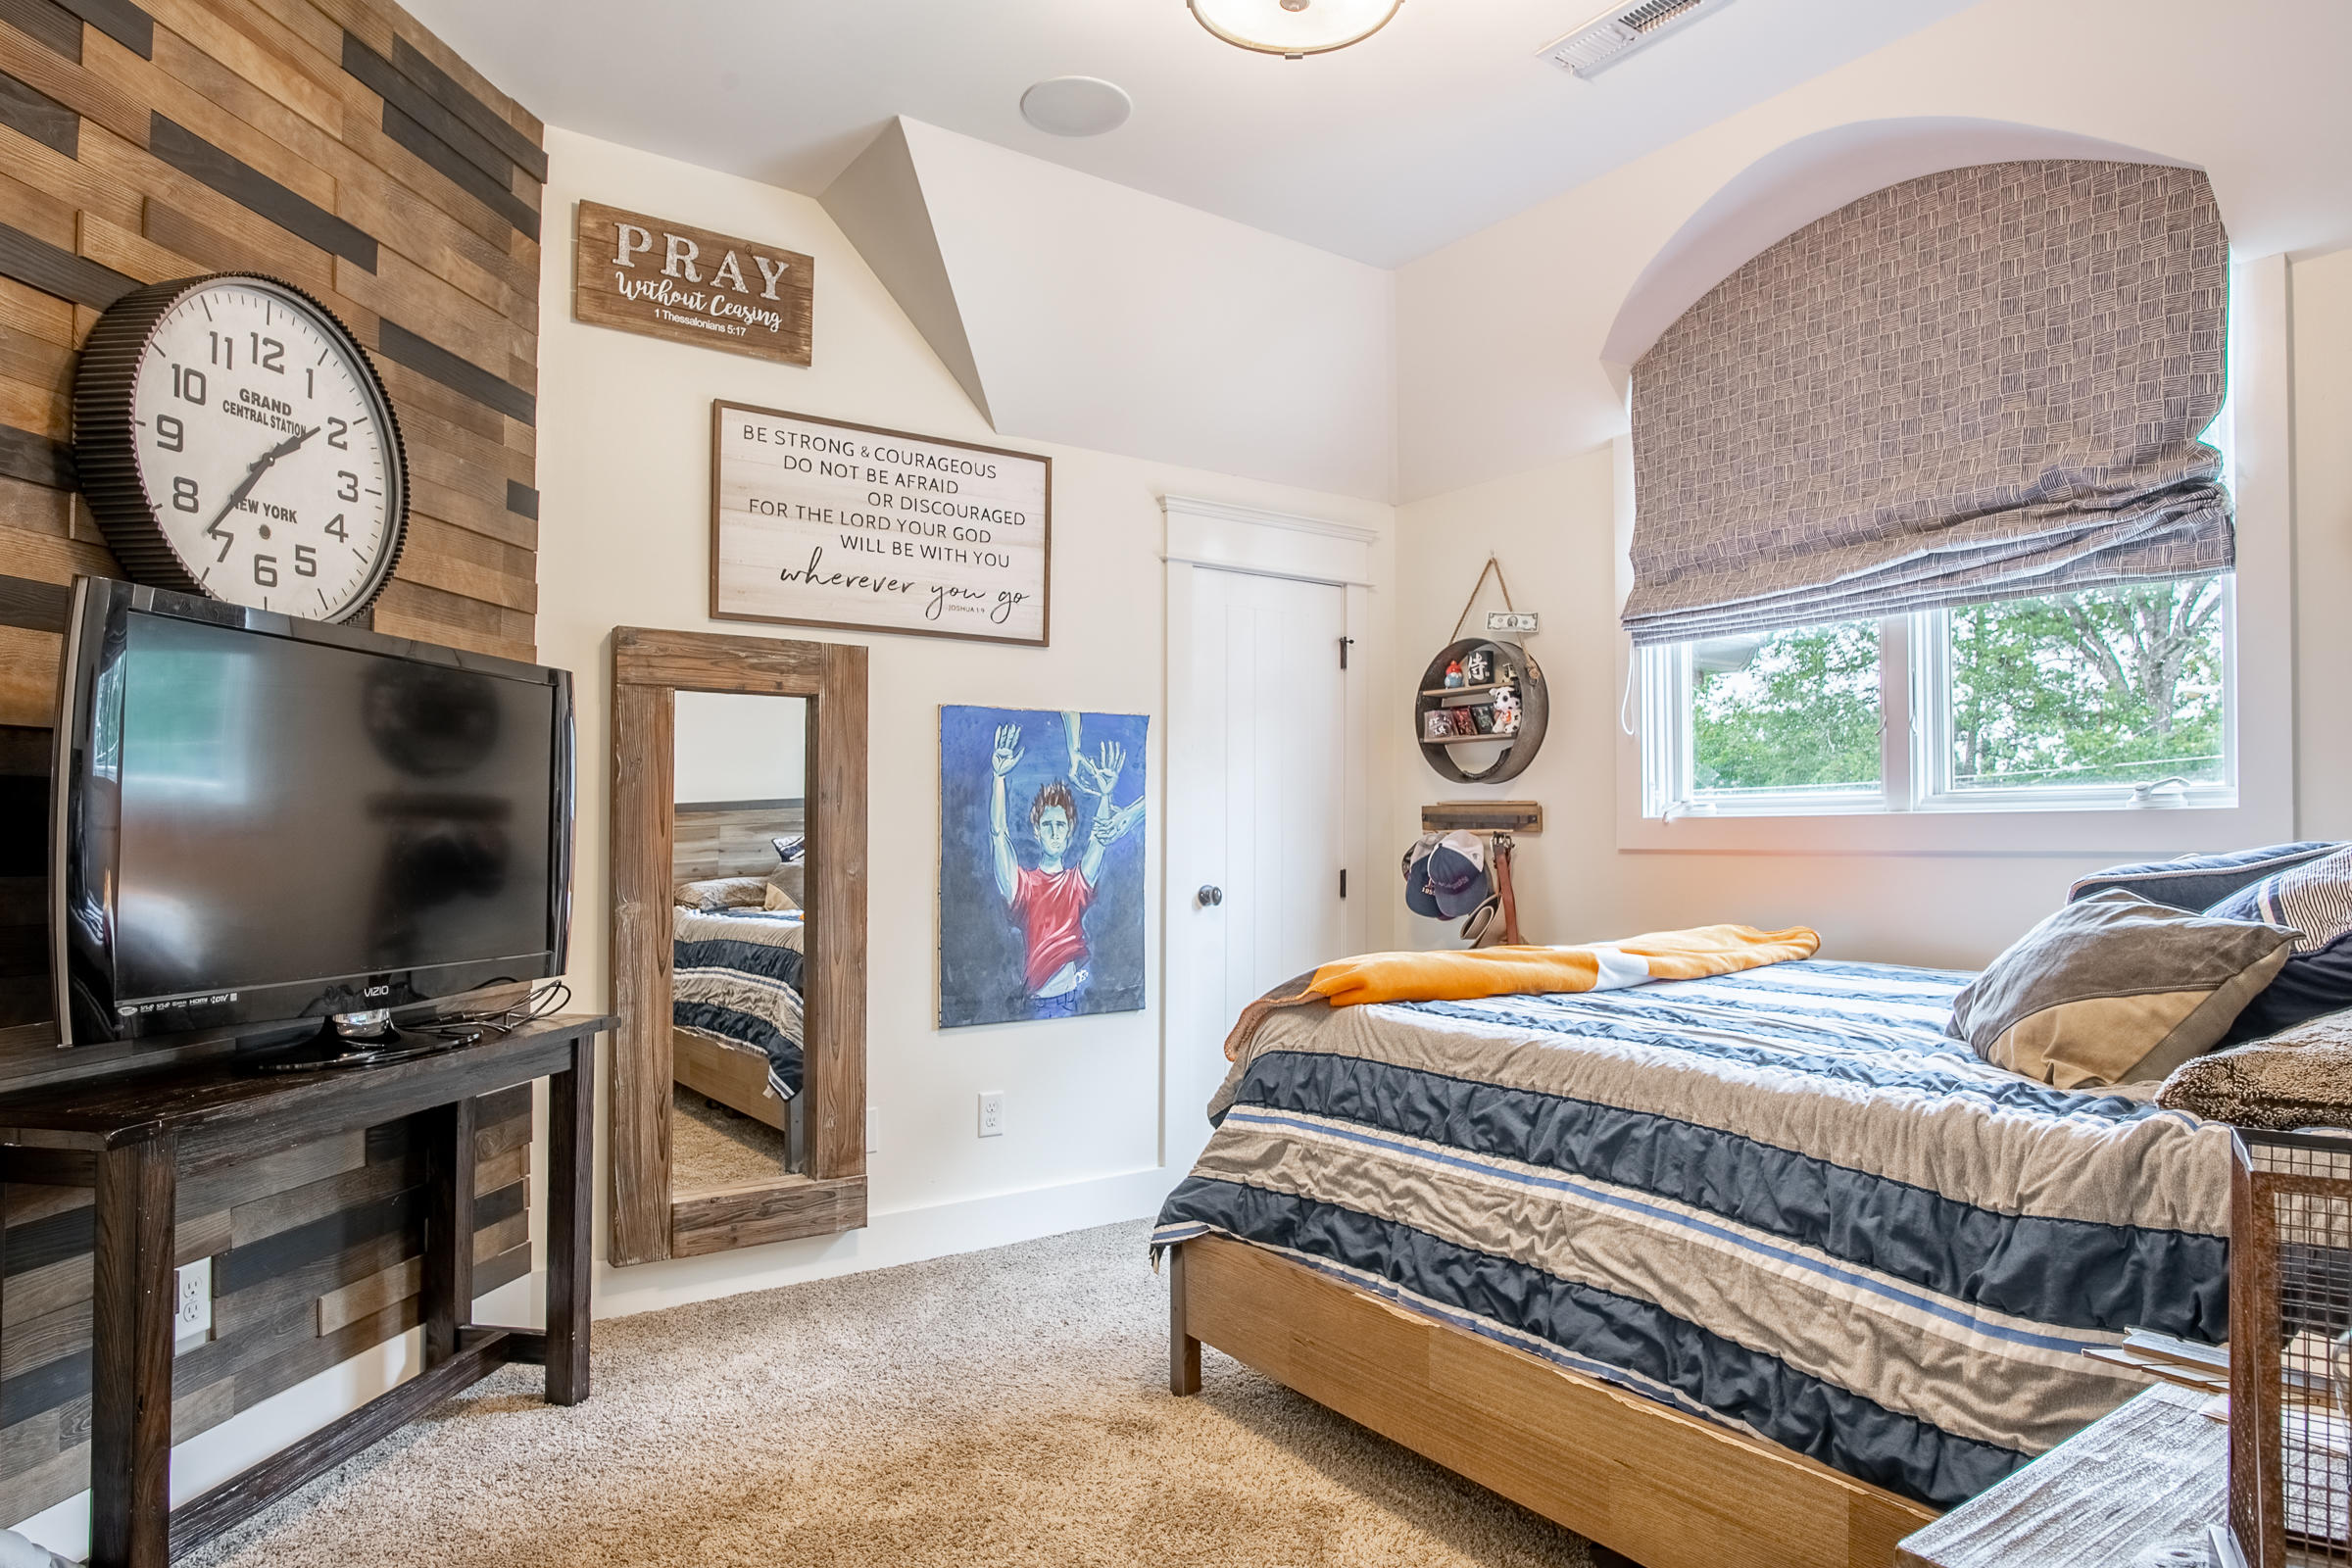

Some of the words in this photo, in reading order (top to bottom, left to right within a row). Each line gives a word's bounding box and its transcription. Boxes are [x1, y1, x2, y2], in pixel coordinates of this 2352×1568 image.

[612, 221, 789, 301] PRAY
[615, 270, 707, 310] Without
[710, 295, 782, 333] Ceasing
[655, 308, 661, 318] 1
[662, 309, 726, 333] Thessalonians
[727, 325, 747, 337] 5:17
[209, 331, 233, 370] 11
[250, 331, 285, 374] 12
[172, 363, 207, 406] 10
[306, 368, 315, 399] 1
[222, 399, 270, 426] CENTRAL
[270, 414, 308, 438] STATION
[239, 387, 293, 416] GRAND
[157, 414, 184, 453] 9
[327, 416, 349, 451] 2
[743, 424, 767, 443] BE
[774, 429, 856, 458] STRONG
[861, 445, 870, 458] &
[874, 446, 998, 479] COURAGEOUS
[337, 469, 359, 503] 3
[784, 455, 812, 473] DO
[819, 461, 859, 480] NOT
[866, 468, 889, 485] BE
[895, 473, 958, 494] AFRAID
[172, 475, 199, 514] 8
[867, 491, 894, 509] OR
[900, 496, 1026, 526] DISCOURAGED
[263, 502, 298, 524] YORK
[324, 513, 349, 543] 4
[749, 498, 788, 518] FOR
[796, 504, 833, 523] THE
[840, 511, 891, 531] LORD
[897, 518, 948, 539] YOUR
[953, 524, 992, 544] GOD
[211, 529, 234, 564] 7
[294, 544, 318, 578] 5
[840, 534, 886, 554] WILL
[892, 541, 914, 558] BE
[919, 544, 967, 564] WITH
[973, 551, 1010, 568] YOU
[253, 554, 278, 588] 6
[780, 546, 916, 594] wherever
[925, 584, 986, 620] you
[990, 590, 1030, 624] go
[948, 604, 975, 612] JOSHUA
[364, 985, 389, 998] VIZIO
